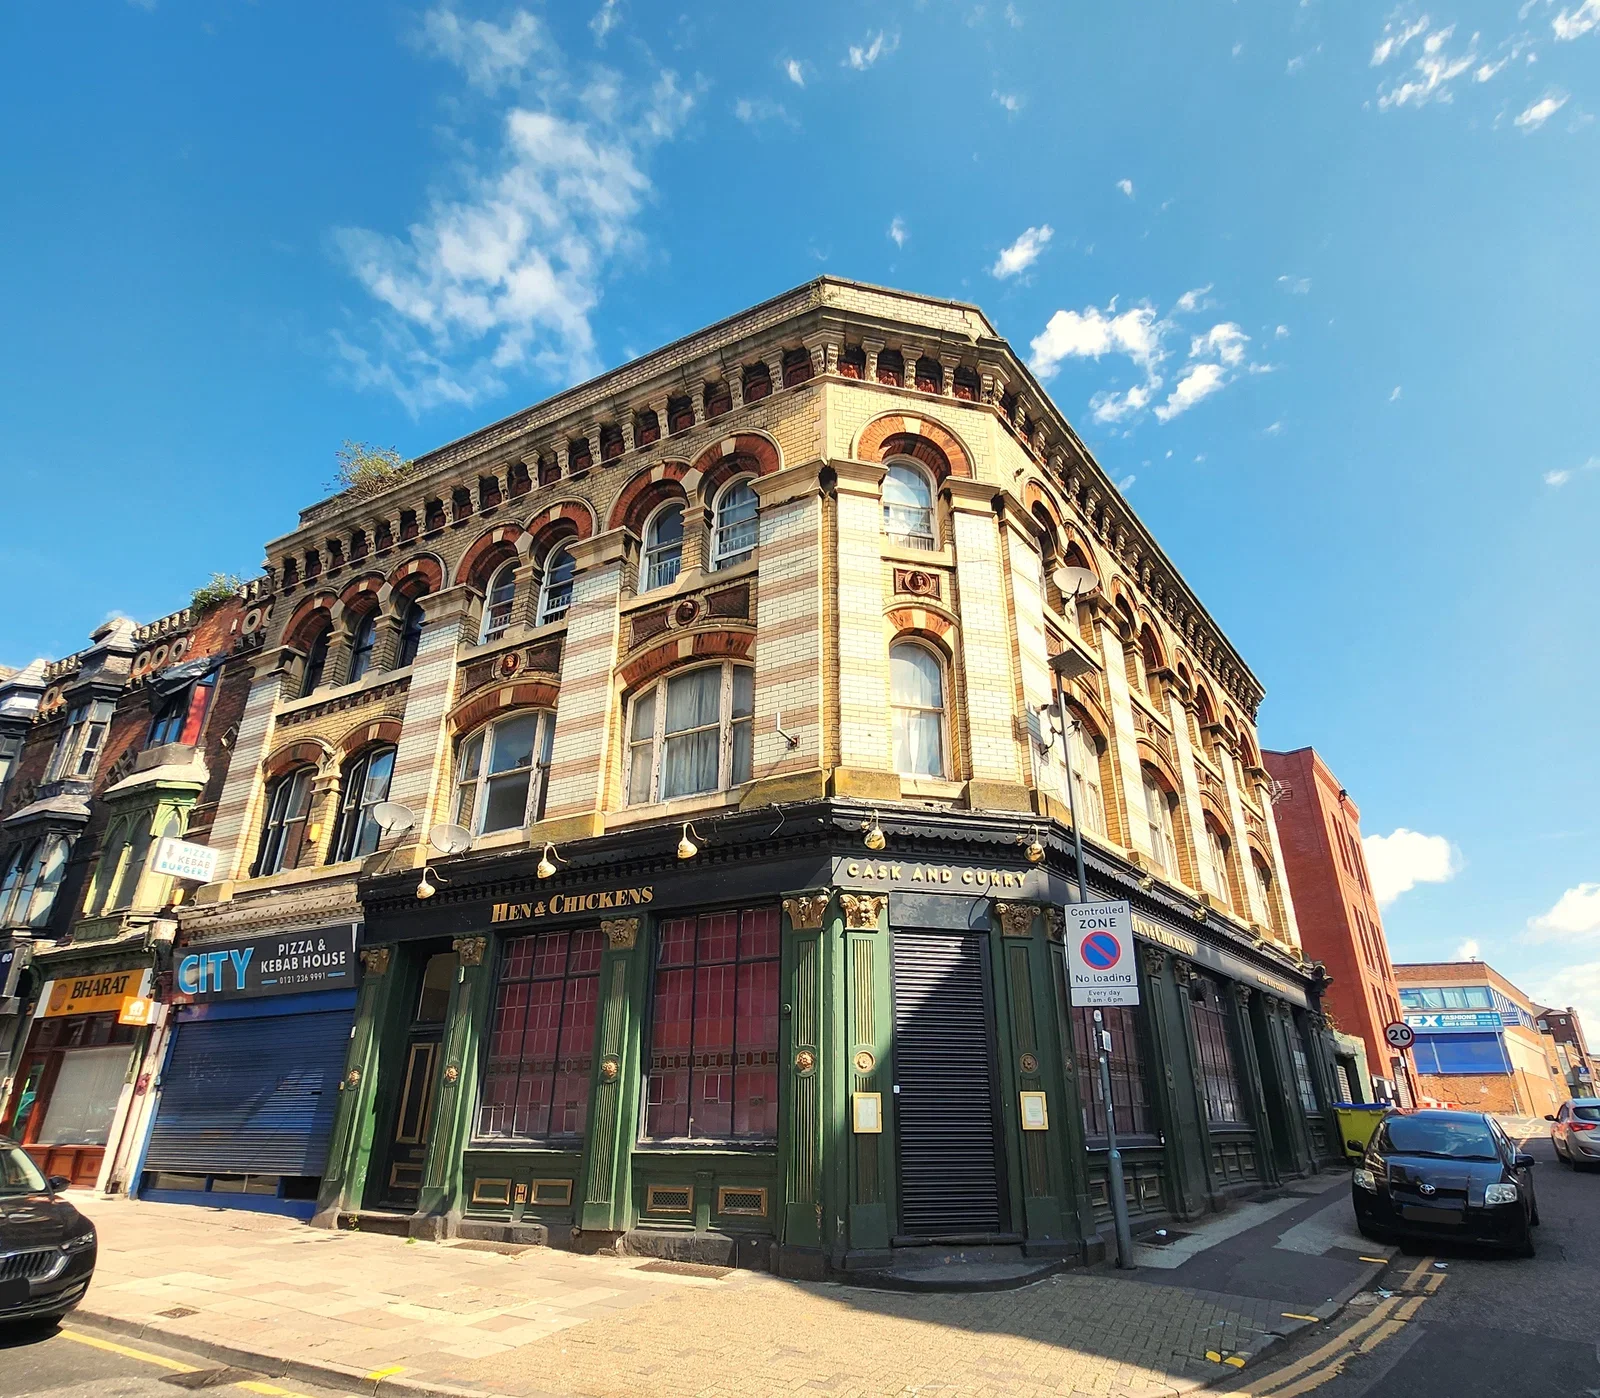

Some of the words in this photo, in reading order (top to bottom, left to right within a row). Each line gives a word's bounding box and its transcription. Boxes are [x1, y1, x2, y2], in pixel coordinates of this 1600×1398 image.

[183, 847, 212, 860] PIZZA
[161, 861, 208, 877] BURGERS
[178, 856, 211, 869] KEBAB
[847, 863, 902, 881] CASK
[911, 867, 953, 884] AND
[961, 870, 1026, 888] CURRY
[534, 901, 546, 917] &
[549, 886, 654, 915] CHICKENS
[1070, 905, 1124, 917] Controlled
[1079, 918, 1117, 929] ZONE
[278, 939, 314, 956] PIZZA
[317, 938, 326, 951] &
[261, 956, 299, 973] KEBAB
[302, 951, 346, 969] HOUSE
[178, 947, 255, 995] CITY
[279, 975, 295, 985] 0121
[296, 974, 309, 983] 236
[310, 972, 327, 981] 9991
[1075, 974, 1090, 983] No
[1093, 973, 1132, 983] loading
[70, 975, 130, 999] BHARAT
[1088, 989, 1107, 997] Every
[1108, 989, 1121, 997] day
[1404, 1015, 1439, 1027] EX
[1388, 1029, 1411, 1041] 20
